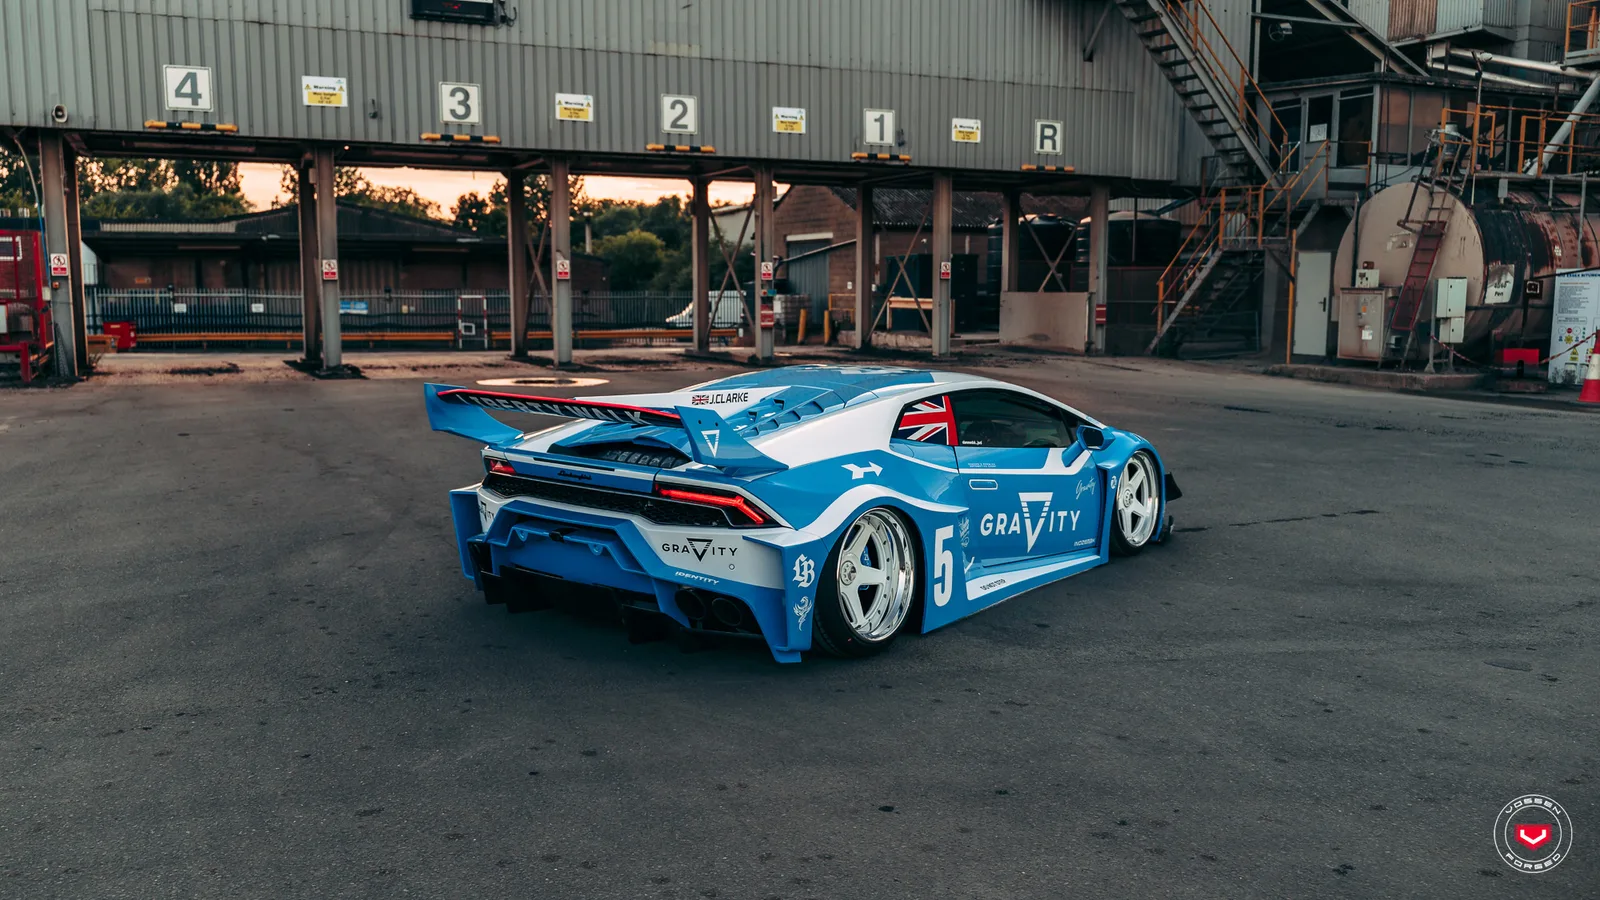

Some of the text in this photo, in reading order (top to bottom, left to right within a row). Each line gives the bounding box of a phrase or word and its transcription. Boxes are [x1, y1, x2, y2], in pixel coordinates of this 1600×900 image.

[175, 71, 202, 106] 4
[450, 87, 471, 120] 3
[670, 99, 688, 129] 2
[874, 114, 884, 141] 1
[1040, 123, 1057, 150] R
[709, 391, 749, 405] J.CLARKE
[565, 405, 652, 425] WALK
[980, 492, 1081, 553] GRAVITY
[661, 537, 738, 562] GRAVITY
[674, 571, 720, 586] IDENTITY
[934, 524, 954, 607] 5
